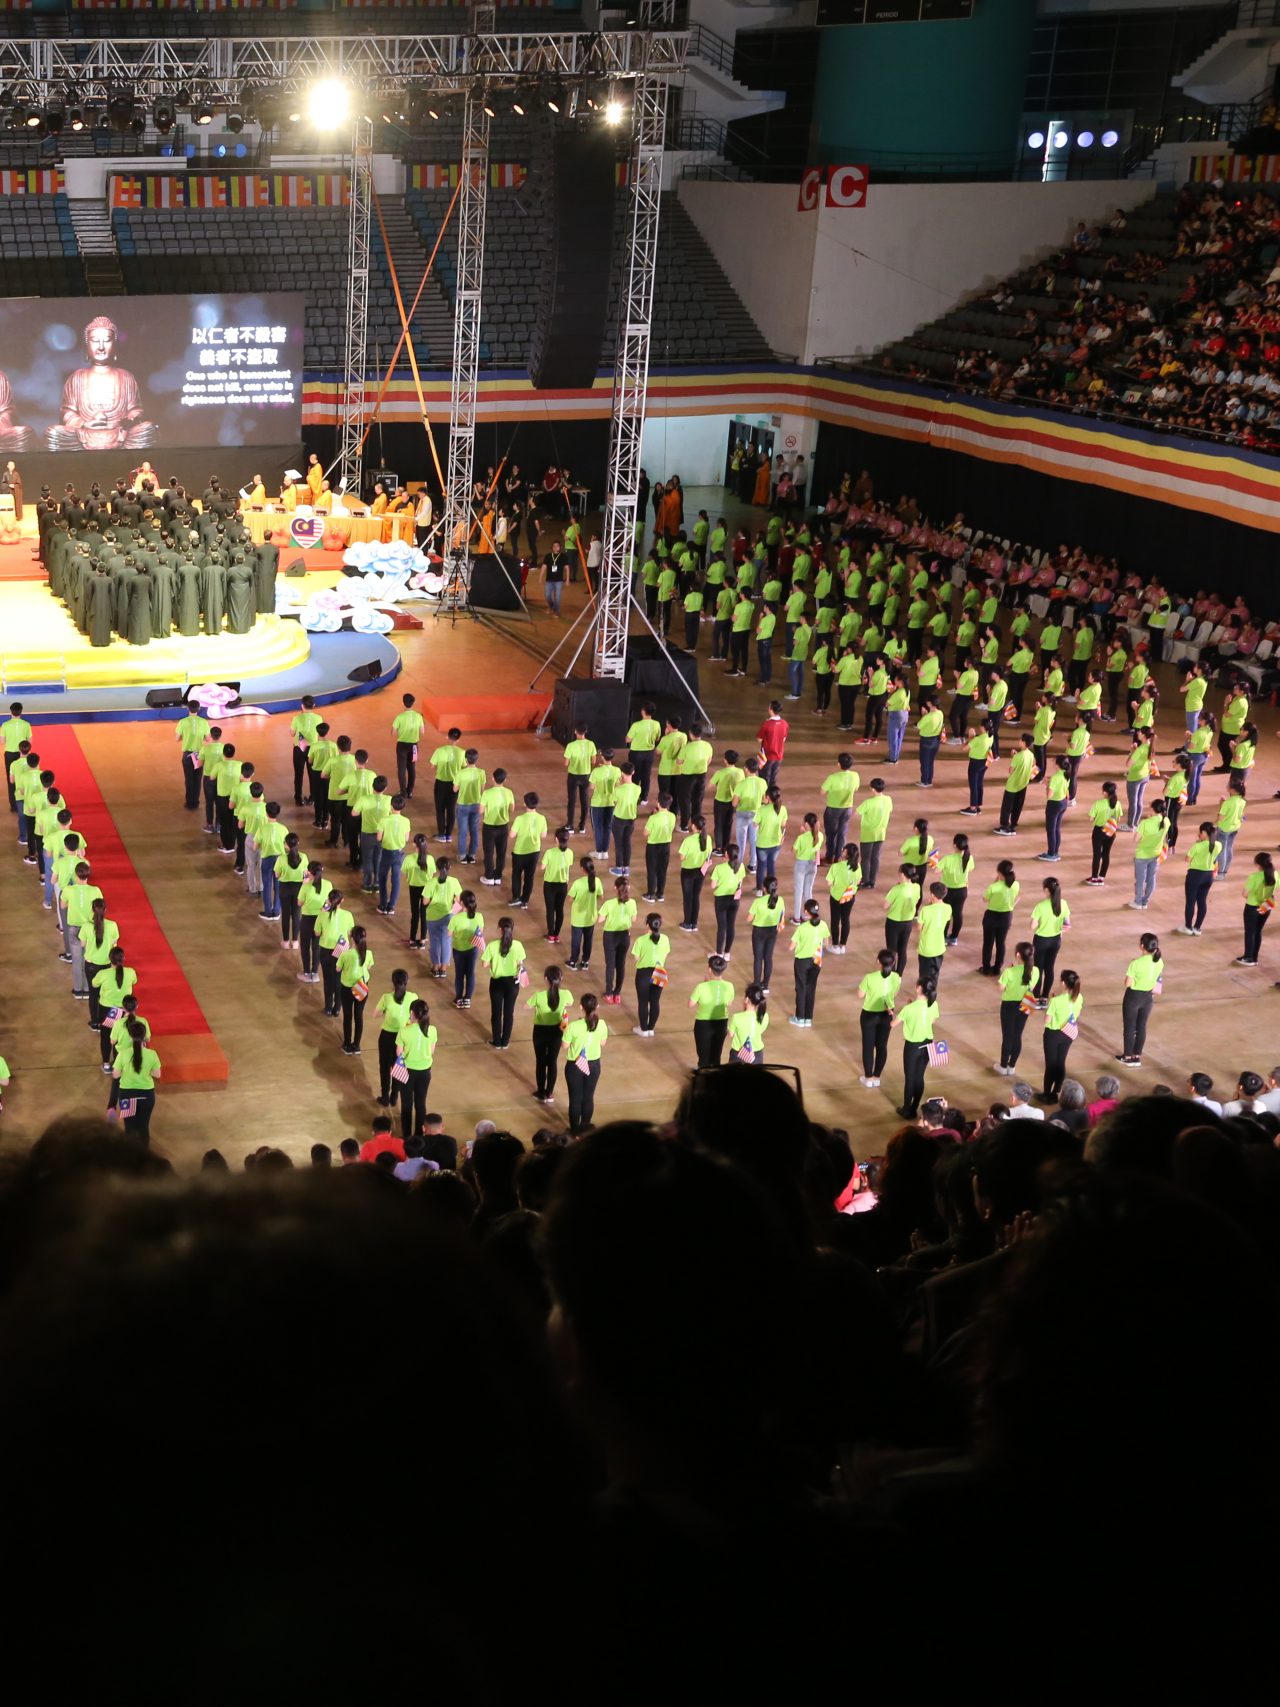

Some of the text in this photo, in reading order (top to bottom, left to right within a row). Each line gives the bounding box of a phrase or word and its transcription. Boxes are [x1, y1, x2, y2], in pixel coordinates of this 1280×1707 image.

[801, 170, 820, 209] C
[831, 166, 864, 206] C
[186, 370, 205, 381] One
[207, 370, 227, 380] who
